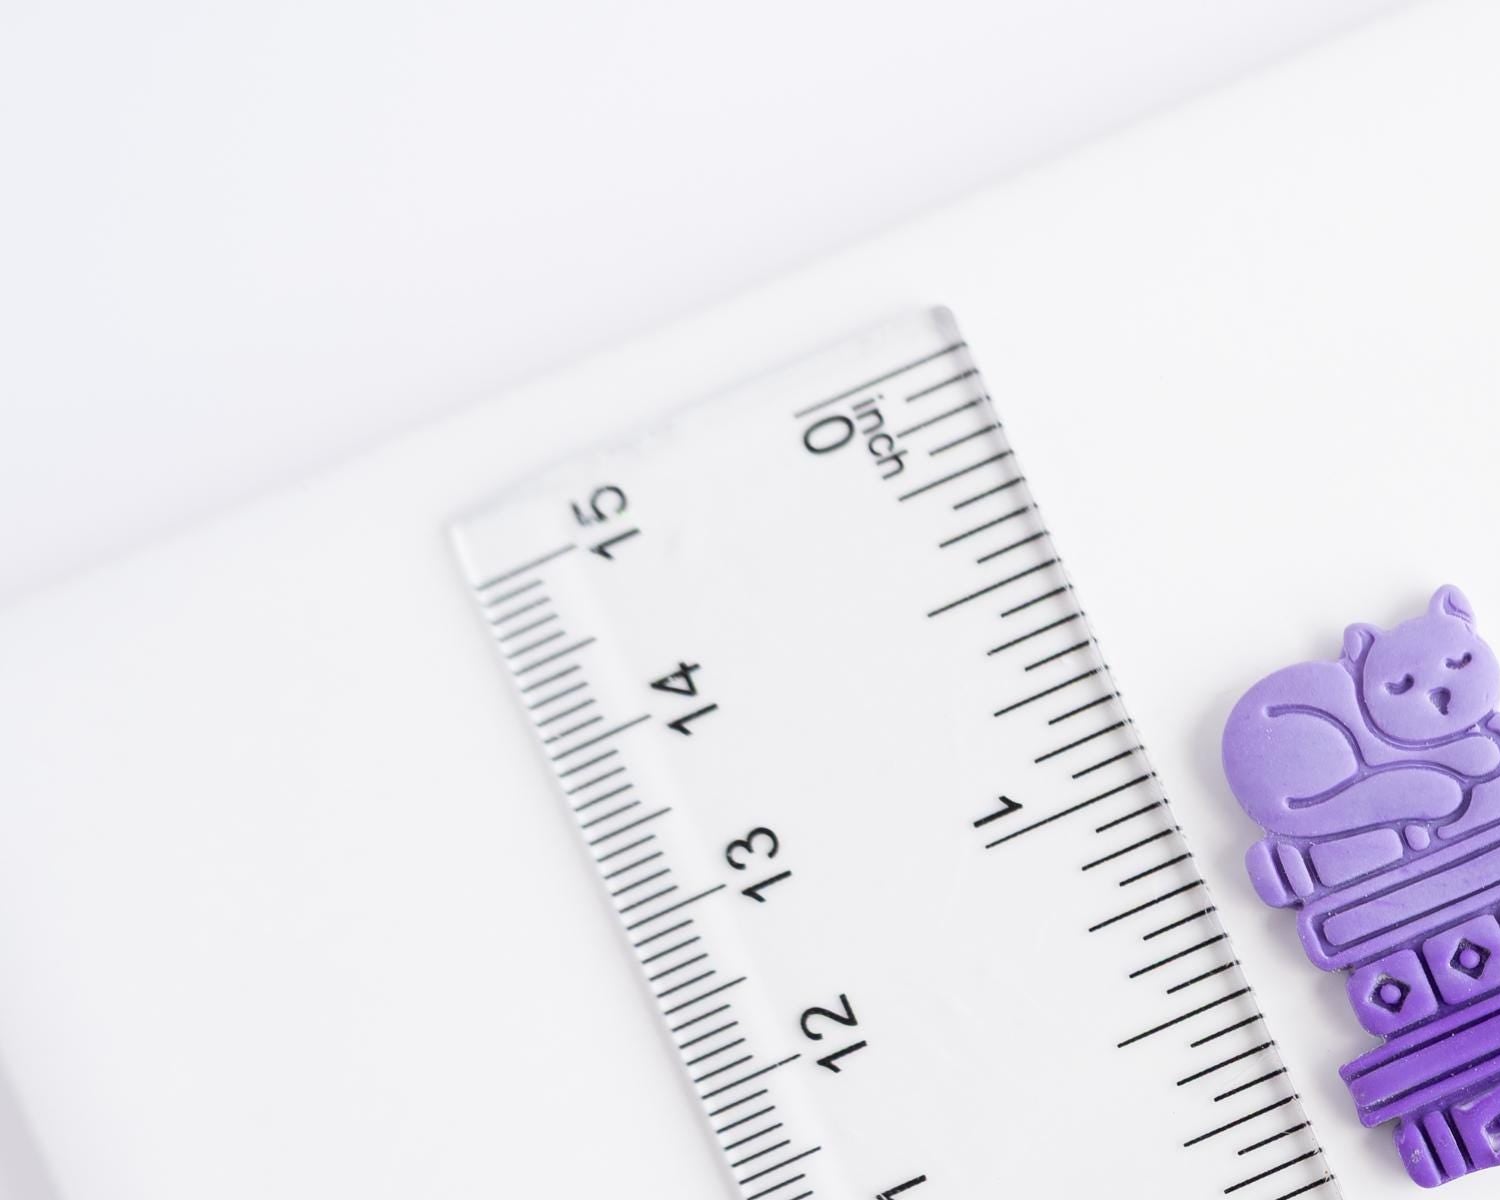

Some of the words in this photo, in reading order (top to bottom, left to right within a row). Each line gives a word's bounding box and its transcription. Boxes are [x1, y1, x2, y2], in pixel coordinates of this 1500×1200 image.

[803, 415, 855, 455] 0
[851, 394, 908, 481] inch
[571, 485, 641, 561] 15
[650, 661, 718, 737] 14
[973, 796, 1023, 829] 1
[724, 826, 792, 904] 13
[800, 993, 868, 1074] 12
